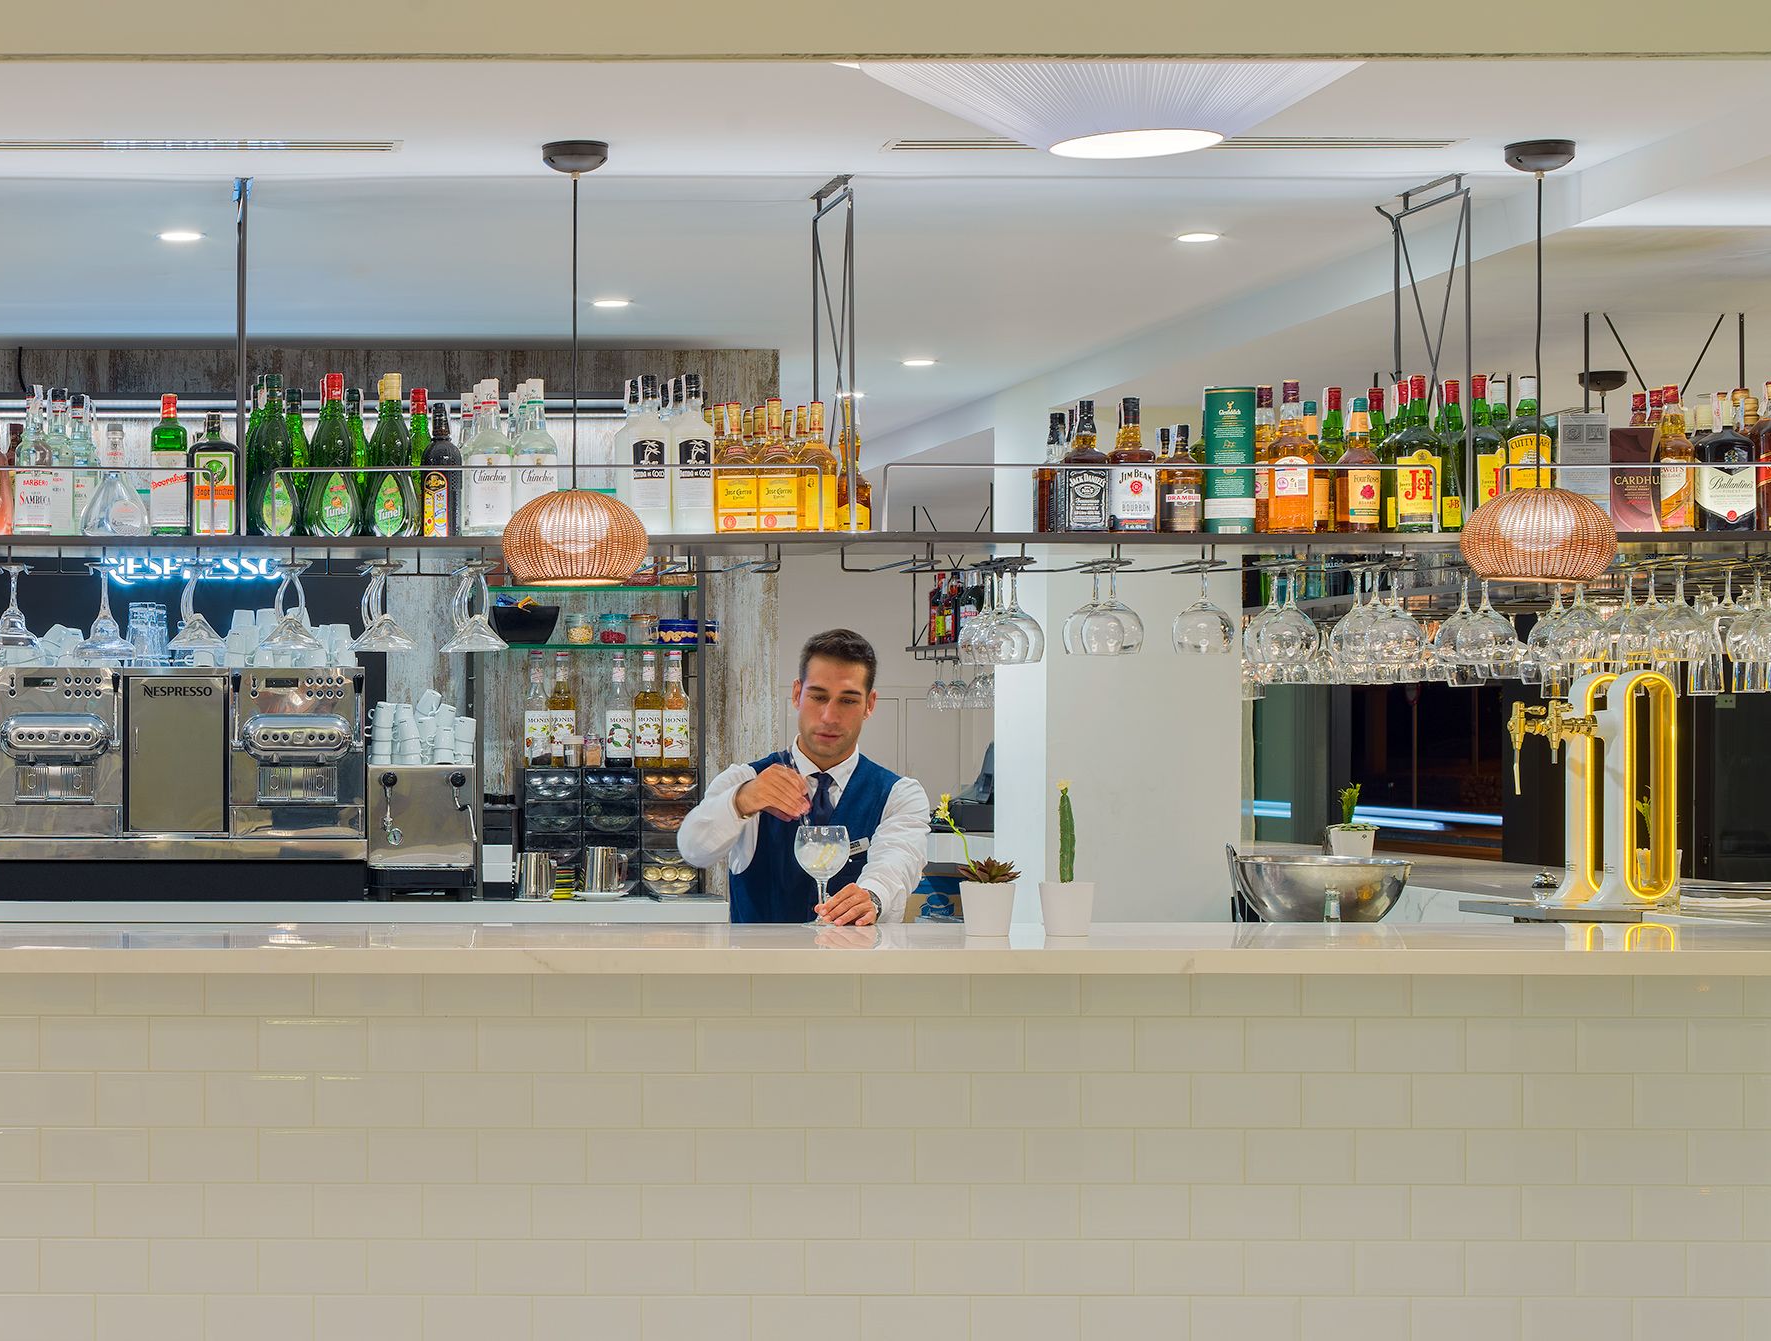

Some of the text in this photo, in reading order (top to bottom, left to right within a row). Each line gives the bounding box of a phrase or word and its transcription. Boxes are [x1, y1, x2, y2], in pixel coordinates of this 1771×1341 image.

[1511, 438, 1535, 450] CUTTY
[1118, 470, 1133, 484] JIM
[1614, 475, 1661, 486] CARDHU
[323, 504, 349, 518] Tunel
[377, 506, 401, 521] Tunel
[141, 684, 212, 698] NESPRESSO
